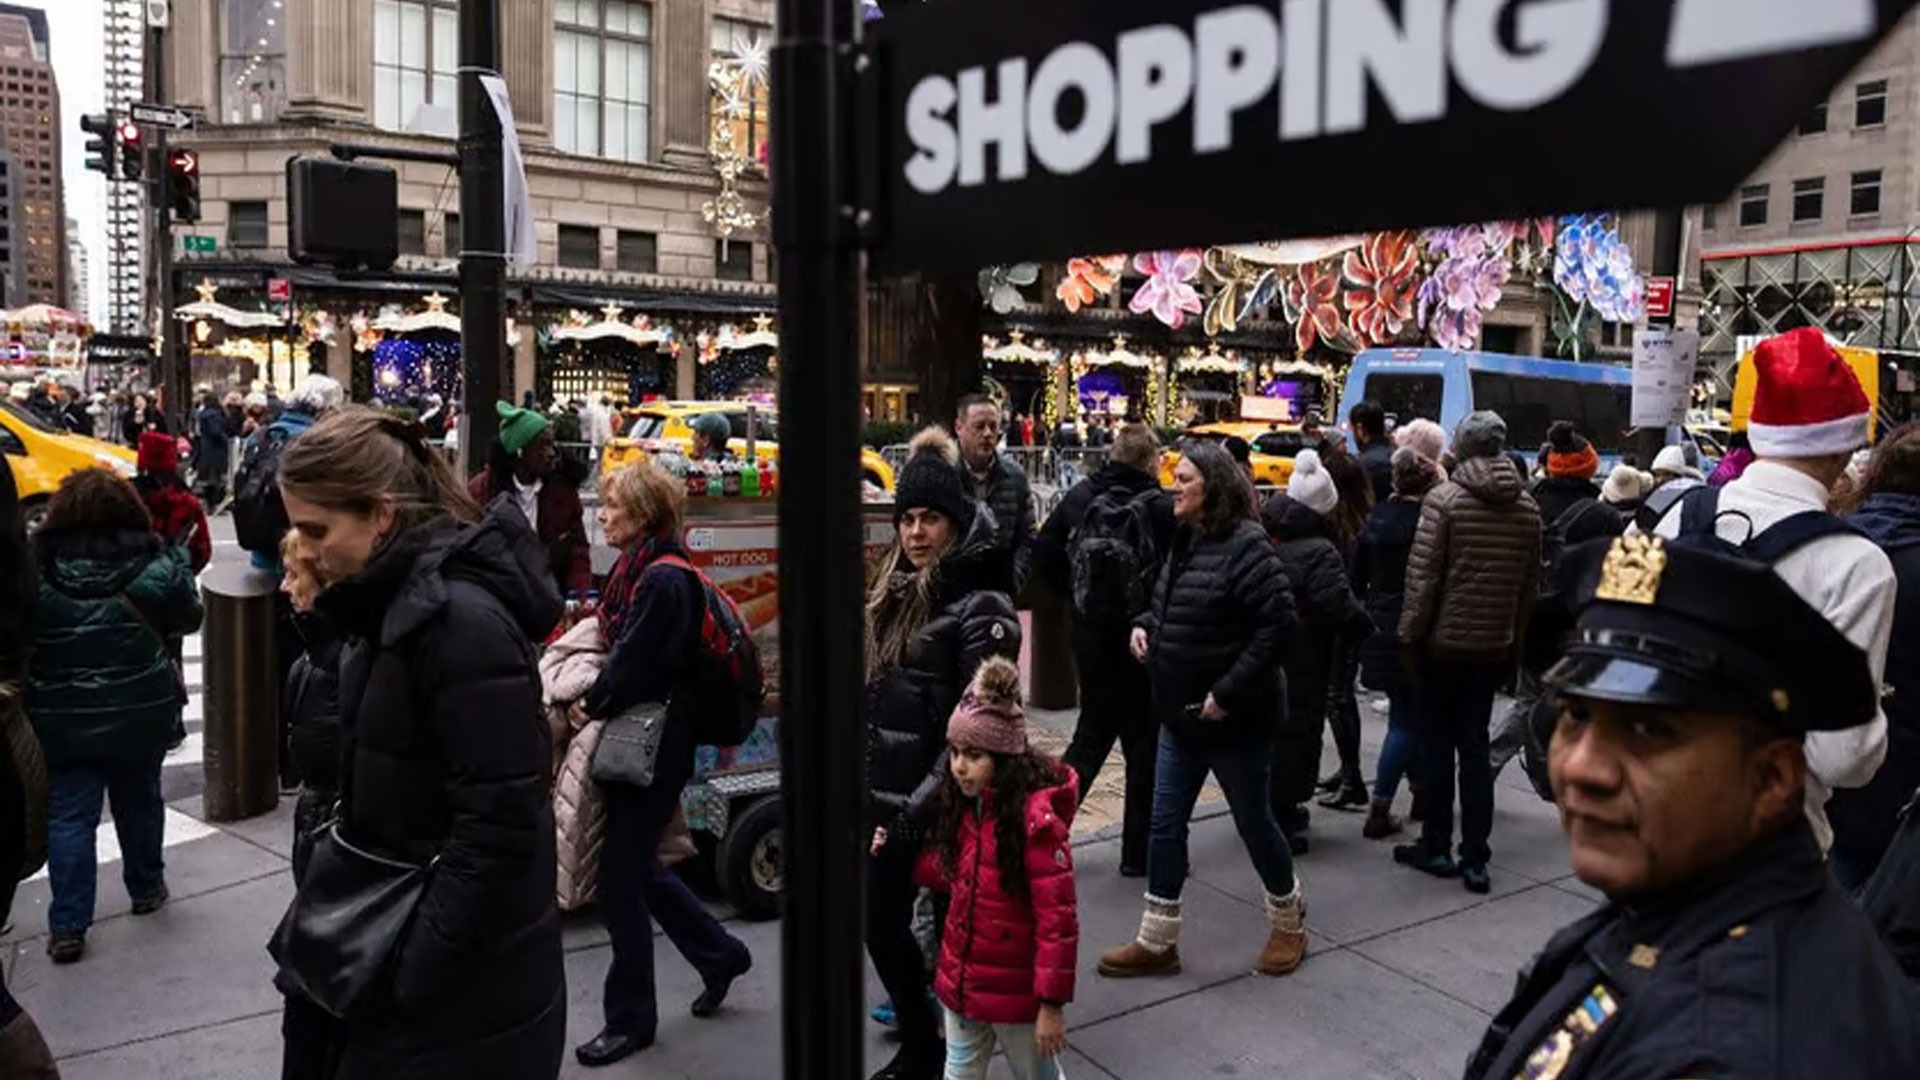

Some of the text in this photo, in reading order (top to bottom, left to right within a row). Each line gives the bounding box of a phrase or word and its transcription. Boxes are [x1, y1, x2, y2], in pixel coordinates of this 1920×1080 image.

[903, 0, 1608, 194] SHOPPING
[713, 552, 768, 567] HOT DOG
